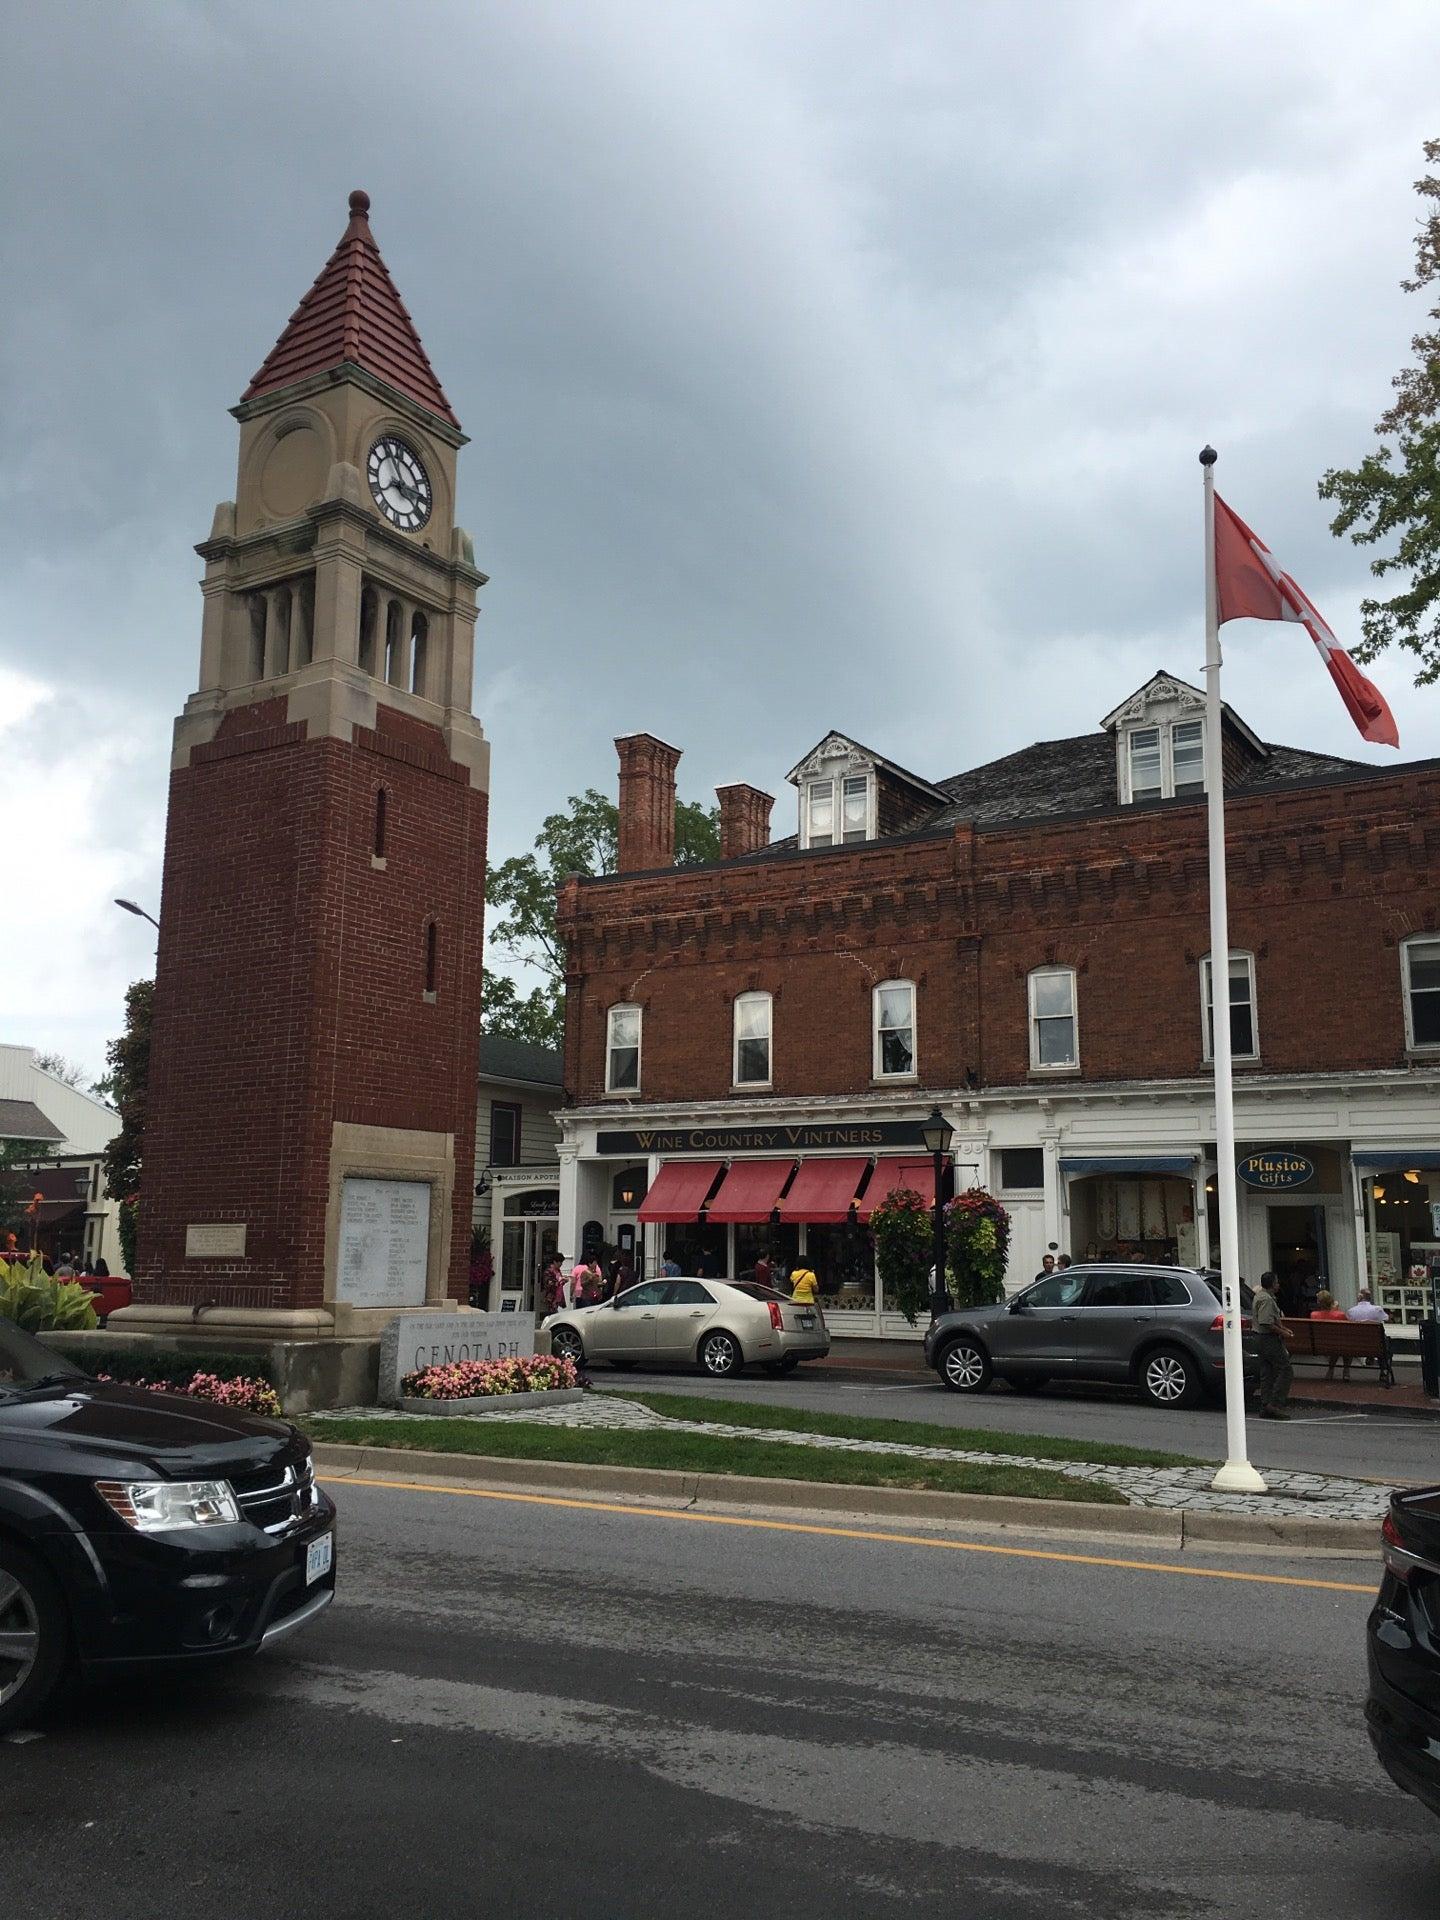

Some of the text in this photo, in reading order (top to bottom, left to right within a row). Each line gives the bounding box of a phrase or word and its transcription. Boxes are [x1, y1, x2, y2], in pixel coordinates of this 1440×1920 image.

[1249, 1157, 1306, 1171] Plusios
[1260, 1172, 1292, 1186] Gifts
[415, 1341, 519, 1371] CENOTAPH
